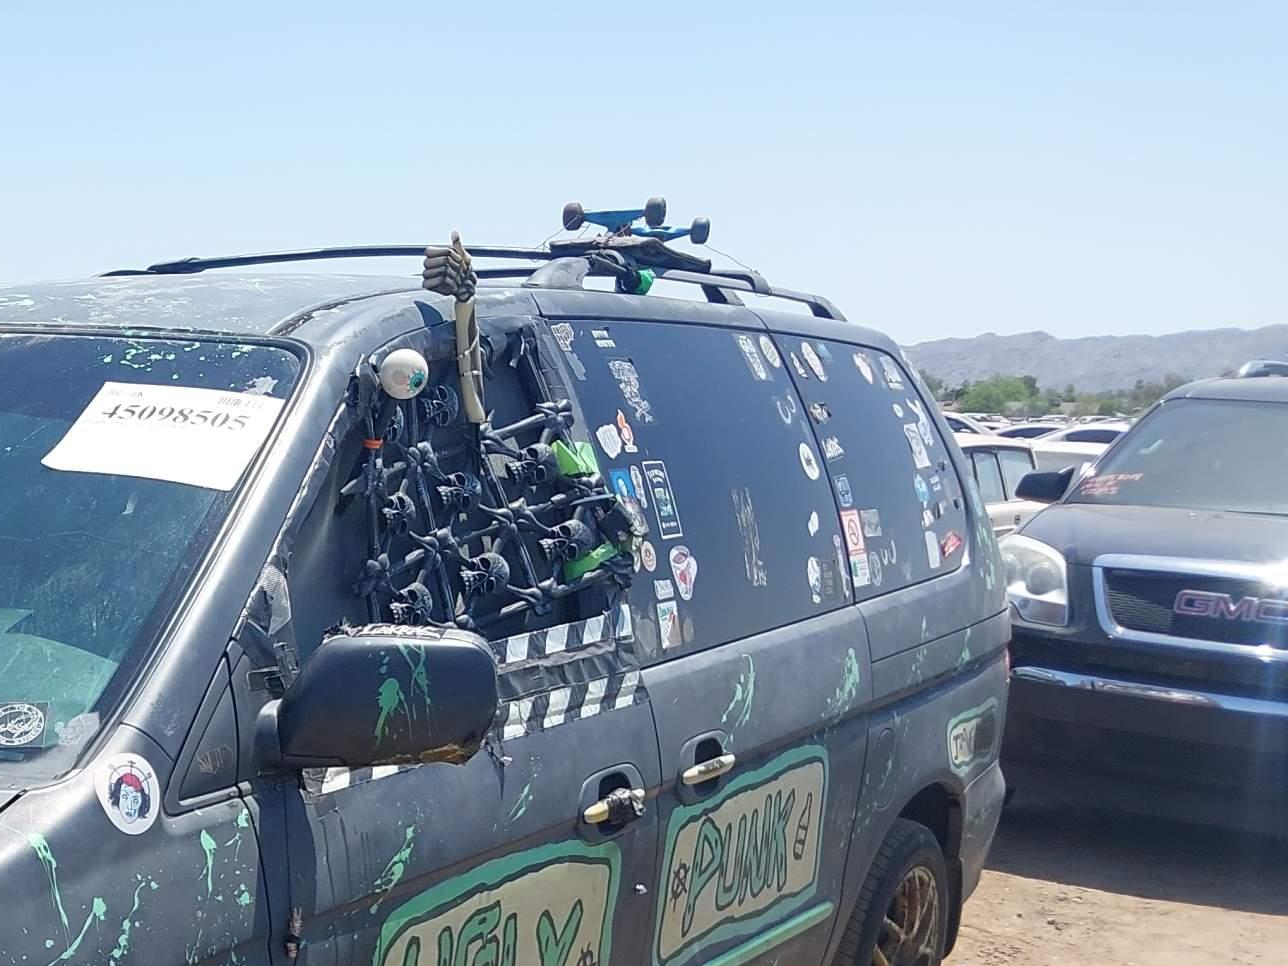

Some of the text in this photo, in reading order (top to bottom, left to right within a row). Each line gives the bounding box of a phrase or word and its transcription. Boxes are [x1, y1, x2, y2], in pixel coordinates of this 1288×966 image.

[102, 403, 252, 430] 45098505
[1174, 589, 1288, 625] GMC
[681, 788, 796, 937] PUNK
